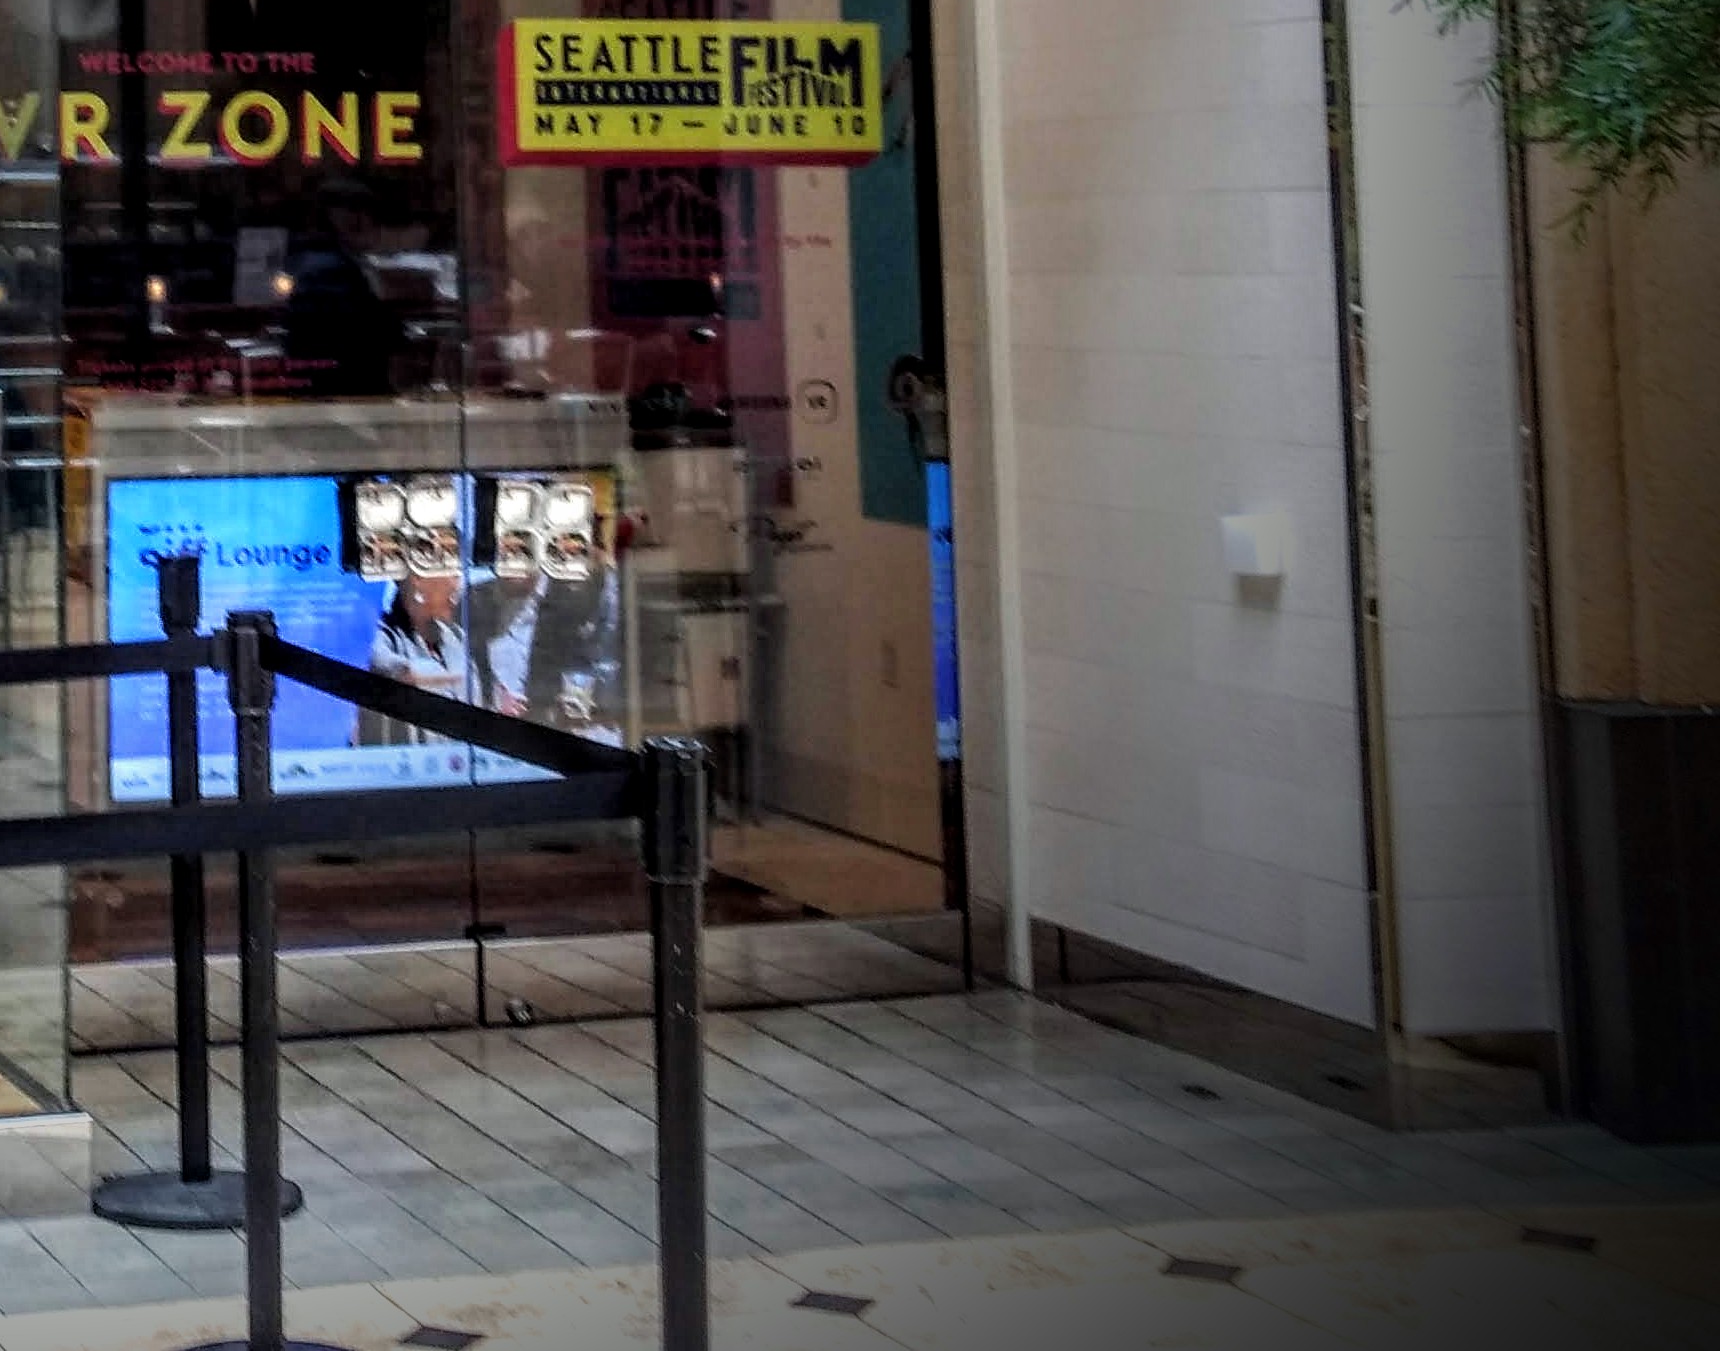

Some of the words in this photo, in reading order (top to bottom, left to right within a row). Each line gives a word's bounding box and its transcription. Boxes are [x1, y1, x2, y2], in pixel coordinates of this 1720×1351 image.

[78, 51, 213, 75] WELCOME
[221, 51, 258, 74] TO
[264, 51, 316, 74] THE
[535, 35, 720, 73] SEATTLE
[730, 36, 864, 107] FILM
[156, 88, 424, 168] ZONE
[535, 112, 601, 135] MAY
[630, 112, 664, 135] 17
[724, 113, 808, 136] JUNE
[833, 114, 867, 136] 10
[215, 540, 332, 572] Lounge
